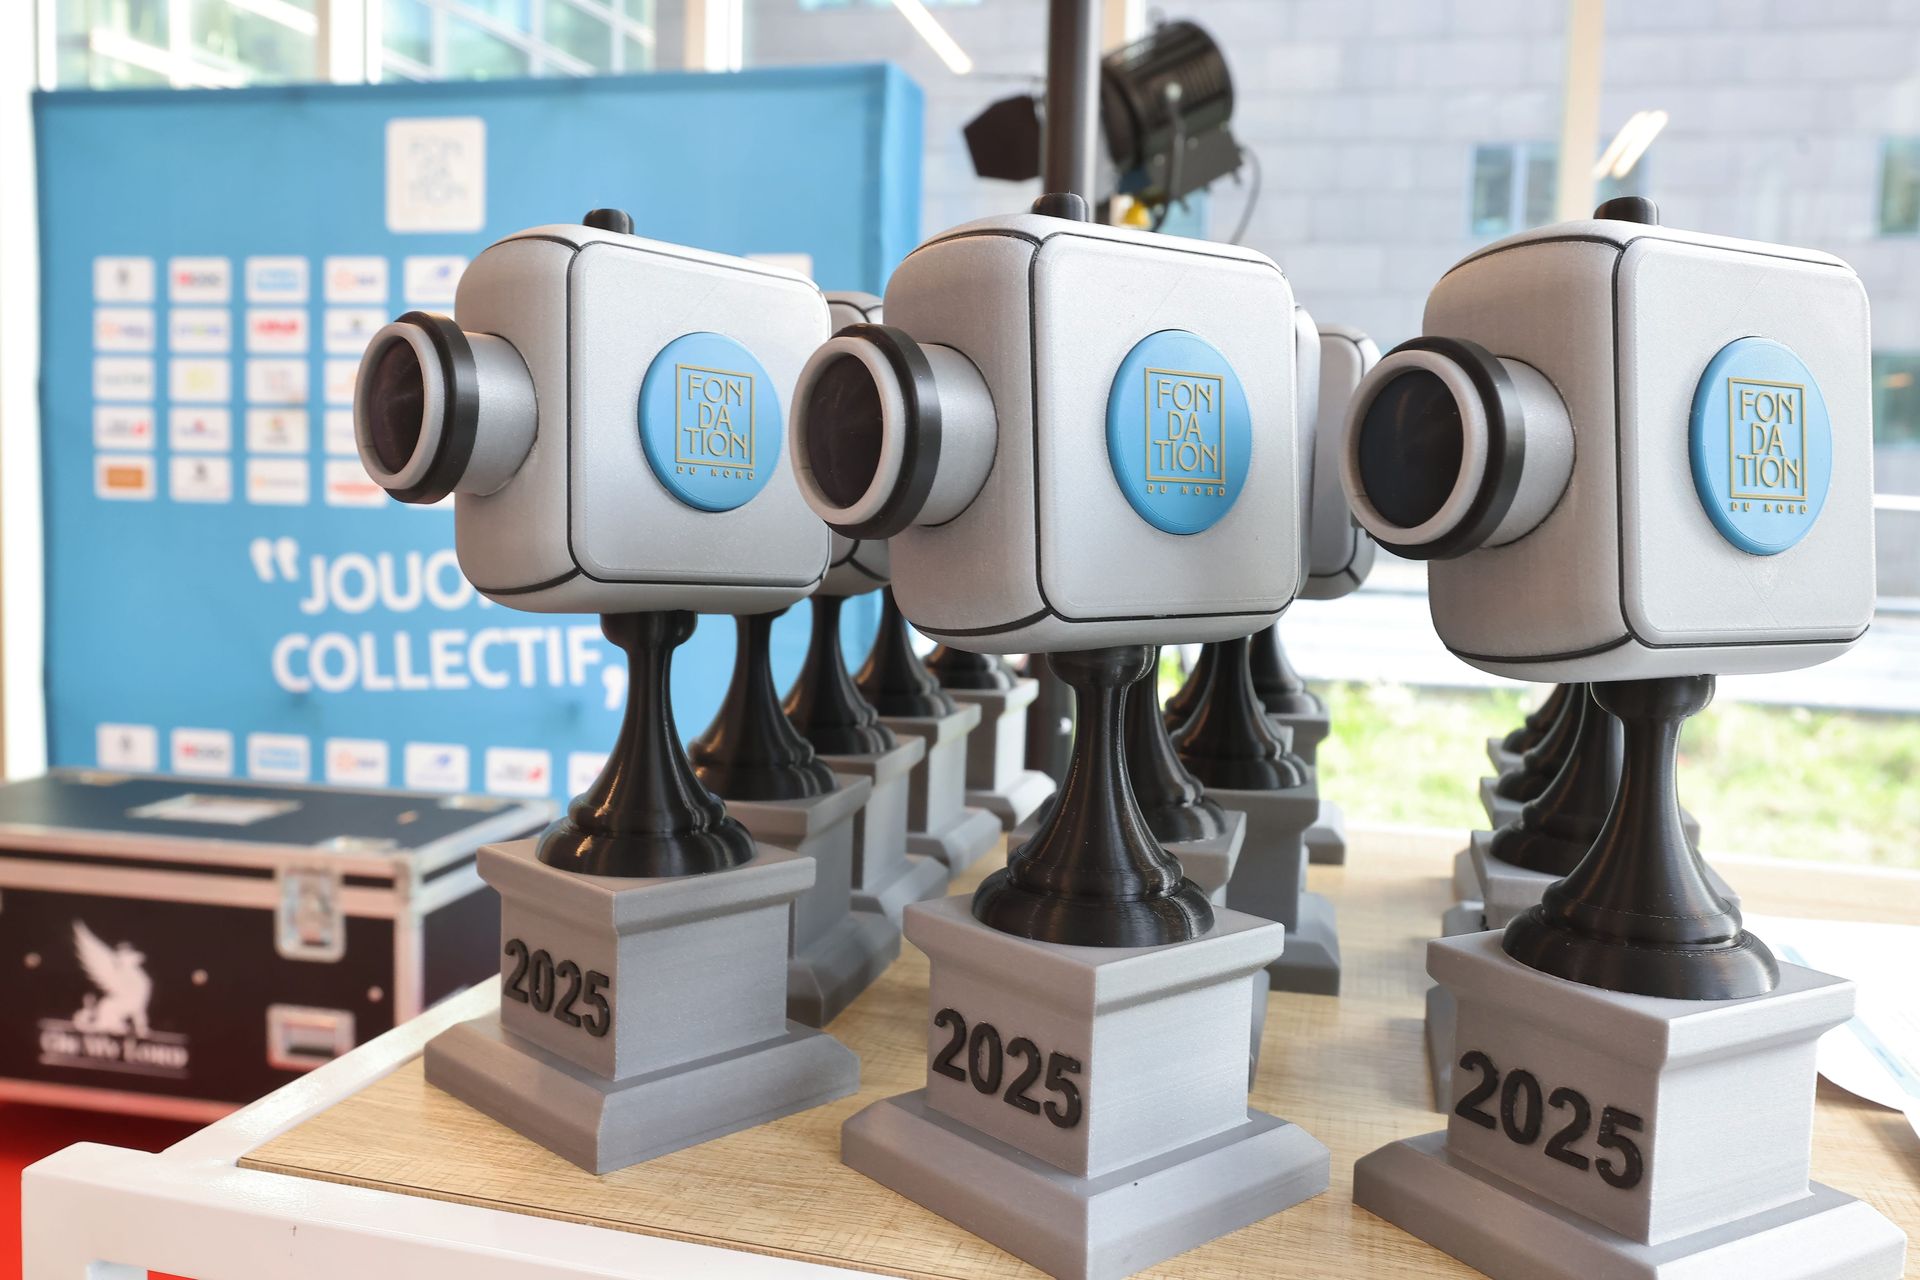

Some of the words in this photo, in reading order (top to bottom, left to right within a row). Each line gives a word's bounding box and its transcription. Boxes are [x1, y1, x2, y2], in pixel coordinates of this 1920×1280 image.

[688, 374, 744, 407] FON
[1157, 379, 1213, 413] FON
[1741, 389, 1796, 424] FON
[699, 402, 733, 432] DA
[1168, 411, 1202, 442] DA
[684, 426, 747, 459] TION
[1153, 439, 1217, 473] TION
[1751, 422, 1785, 456] DA
[676, 465, 697, 475] DU
[711, 469, 756, 480] NORD
[1737, 453, 1800, 488] TION
[1147, 483, 1168, 494] DU
[1182, 485, 1226, 497] NORD
[1730, 501, 1751, 512] DU
[1764, 503, 1809, 515] NORD
[503, 938, 611, 1038] 2025
[932, 1007, 1083, 1129] 2025
[1455, 1049, 1644, 1190] 2025
